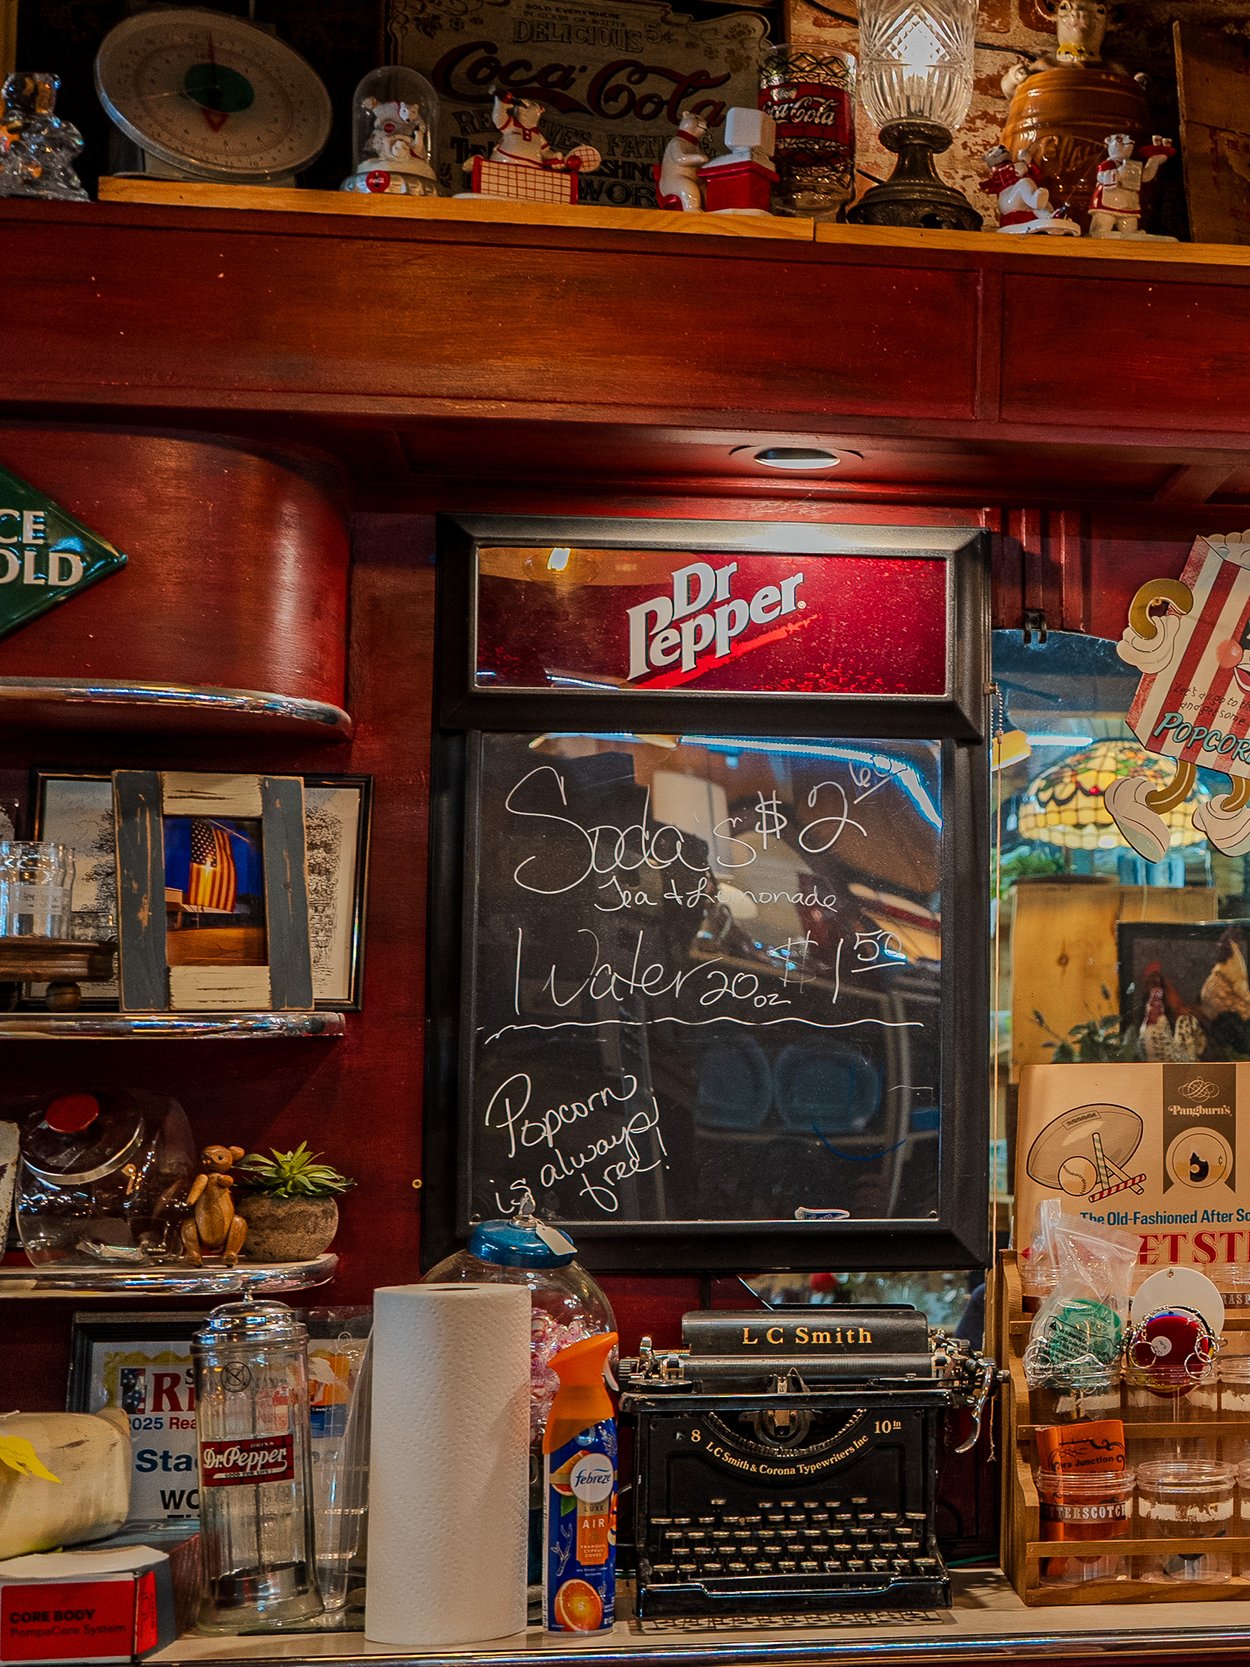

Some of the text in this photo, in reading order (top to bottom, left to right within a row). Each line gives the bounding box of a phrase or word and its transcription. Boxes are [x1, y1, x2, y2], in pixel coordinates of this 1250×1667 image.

[512, 18, 644, 53] DELICIOUS
[431, 41, 731, 127] Coca-Cola
[671, 561, 738, 622] Dr
[626, 573, 805, 681] Pepper
[1180, 700, 1201, 711] and
[1199, 705, 1218, 718] get
[1227, 697, 1239, 708] to
[594, 875, 838, 912] Tea Lemonade
[485, 1073, 638, 1158] Popcorn
[1167, 1104, 1232, 1118] Pangburn's
[540, 1096, 660, 1188] always
[1107, 1210, 1198, 1227] Old-Fashioned
[1200, 1208, 1234, 1224] After
[742, 1326, 873, 1345] L C Smith
[691, 1429, 701, 1443] 8
[706, 1434, 869, 1476] L C Smith & Corona Typewriters Inc
[1074, 1455, 1115, 1468] Junction
[574, 1469, 612, 1488] febreze
[583, 1503, 605, 1513] LUXE
[581, 1519, 606, 1529] AIR
[8, 1608, 96, 1624] CORE BODY
[83, 1623, 127, 1639] System
